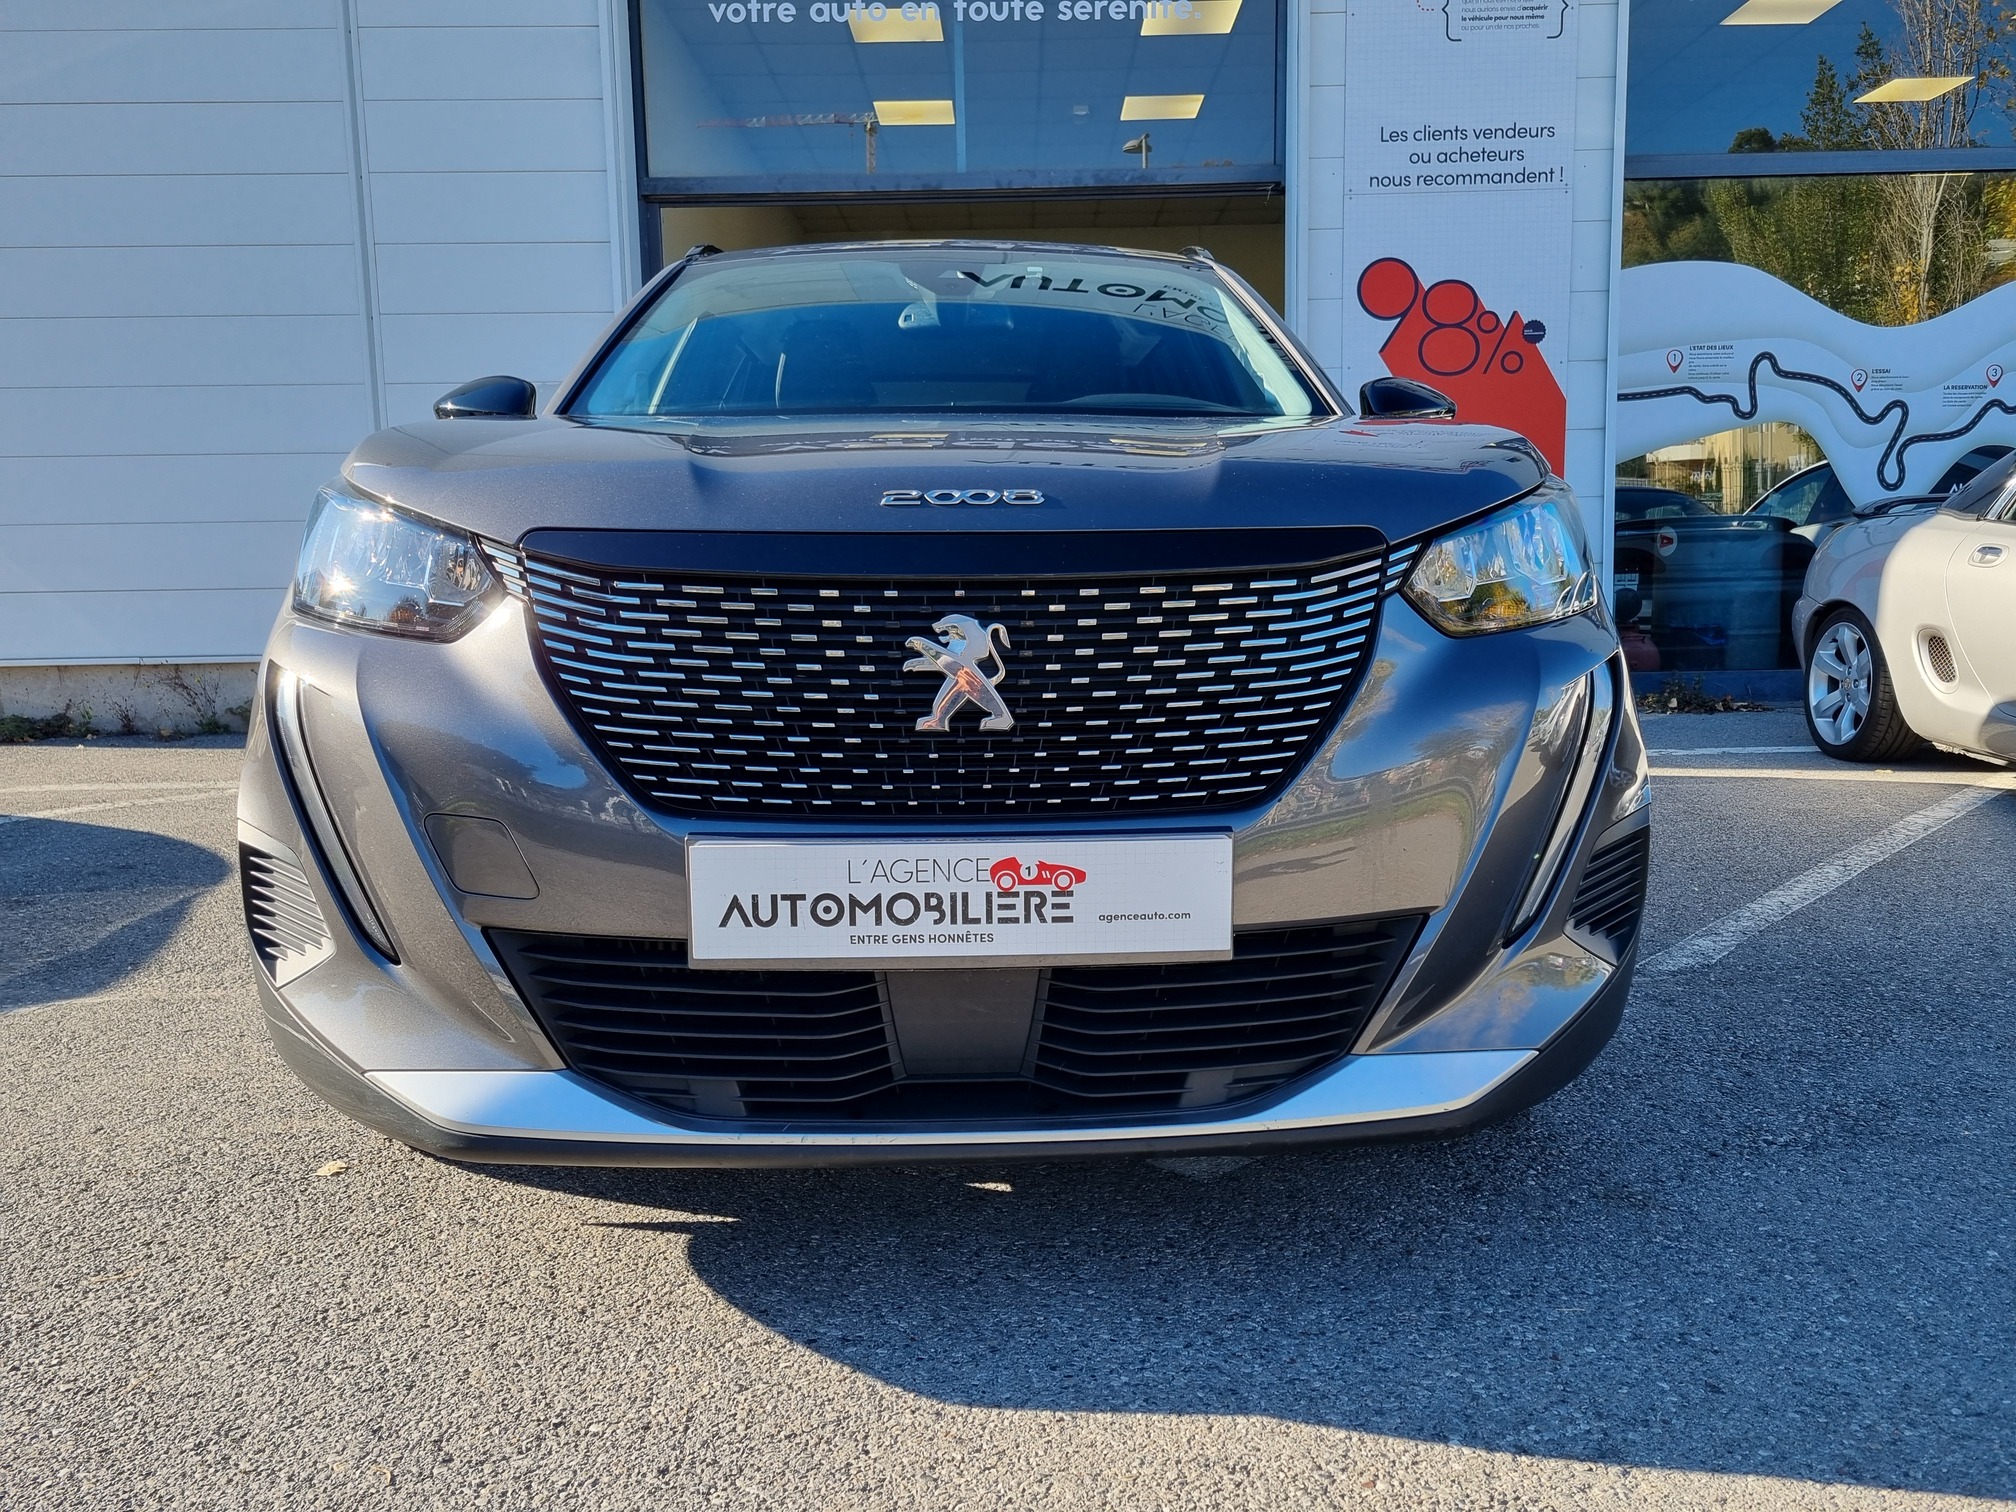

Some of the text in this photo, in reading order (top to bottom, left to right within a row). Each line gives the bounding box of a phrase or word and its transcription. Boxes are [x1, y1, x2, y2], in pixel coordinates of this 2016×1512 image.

[708, 1, 796, 23] votre
[809, 0, 887, 22] auto
[901, 1, 940, 21] en
[953, 0, 1045, 21] toute
[1461, 14, 1468, 22] le
[1467, 14, 1493, 22] véhicule
[1494, 14, 1508, 22] pour
[1380, 121, 1556, 143] Les clients vendeurs
[1409, 146, 1526, 165] ou acheteurs
[1369, 166, 1564, 188] nous recommandent !
[1357, 257, 1523, 377] 98%
[1856, 372, 1863, 382] 2
[1991, 368, 1998, 377] 3
[880, 488, 1045, 506] 2008
[847, 857, 991, 885] L'AGENCE
[1024, 864, 1033, 878] 1
[718, 889, 1075, 928] AUTOMOBILIERE
[1098, 910, 1192, 924] agenceauto.com
[849, 930, 995, 945] ENTRE GENS HONNÊTES
